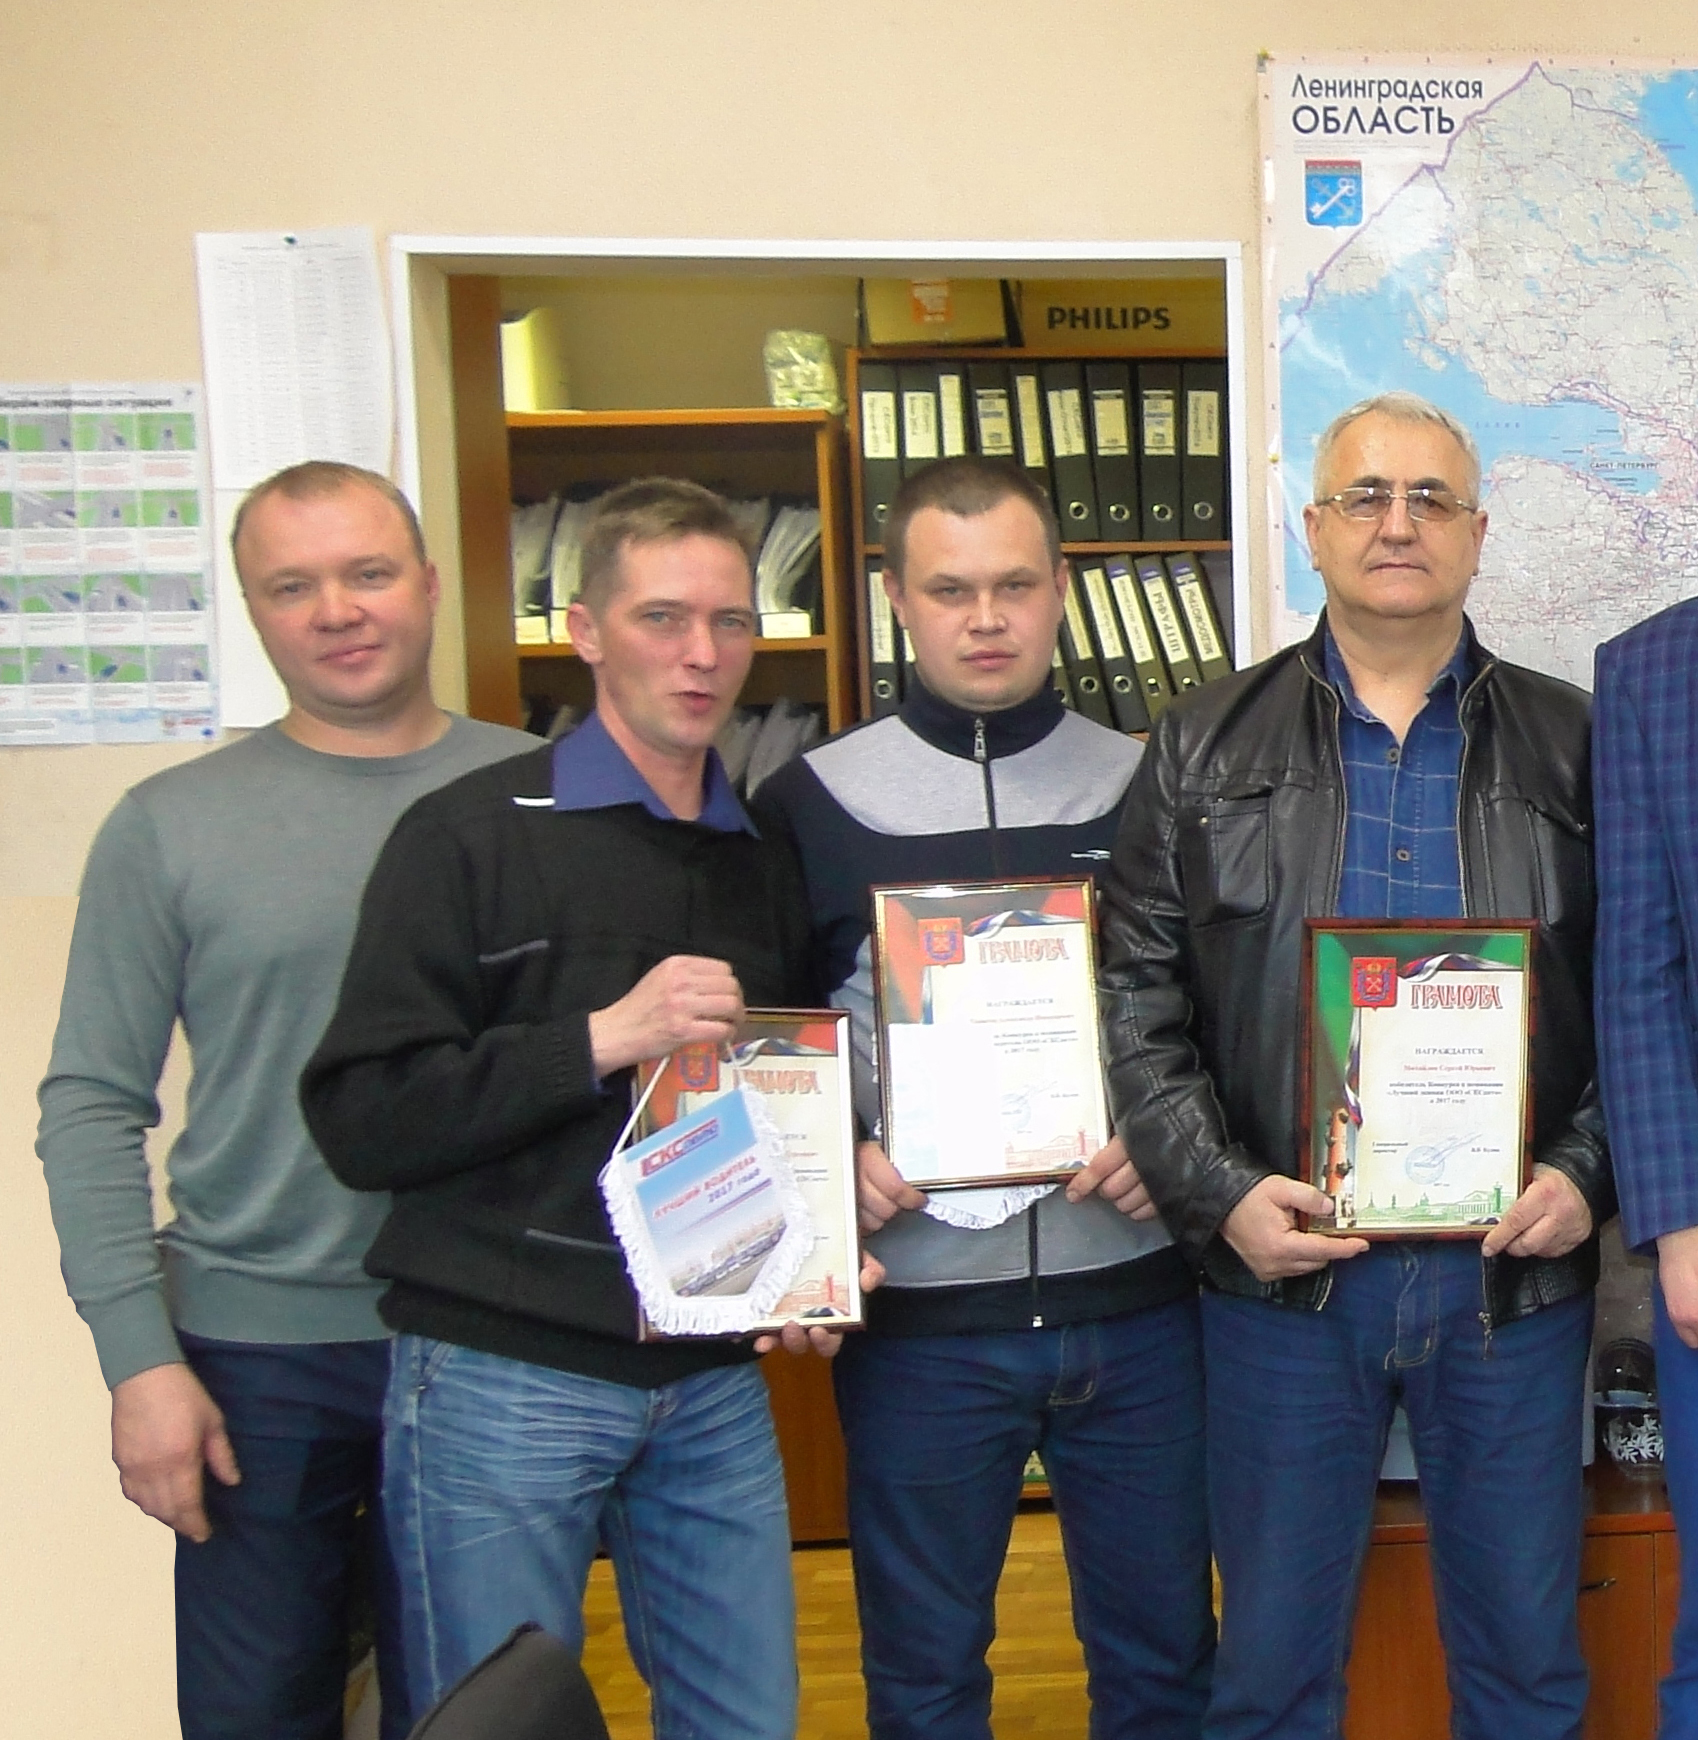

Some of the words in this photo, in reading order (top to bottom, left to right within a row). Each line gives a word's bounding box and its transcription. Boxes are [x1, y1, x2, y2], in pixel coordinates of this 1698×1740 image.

[1292, 74, 1483, 103] Ленинградская
[1293, 105, 1455, 134] ОБЛАСТЬ
[1047, 306, 1171, 330] PHILIPS
[1152, 590, 1181, 652] ШТРАФЫ
[979, 938, 1069, 964] ГРАМОТА
[1411, 984, 1503, 1009] ГРАМОТА
[1415, 1047, 1484, 1056] НАГРАЖДАЕТСЯ
[708, 1181, 734, 1203] 2017
